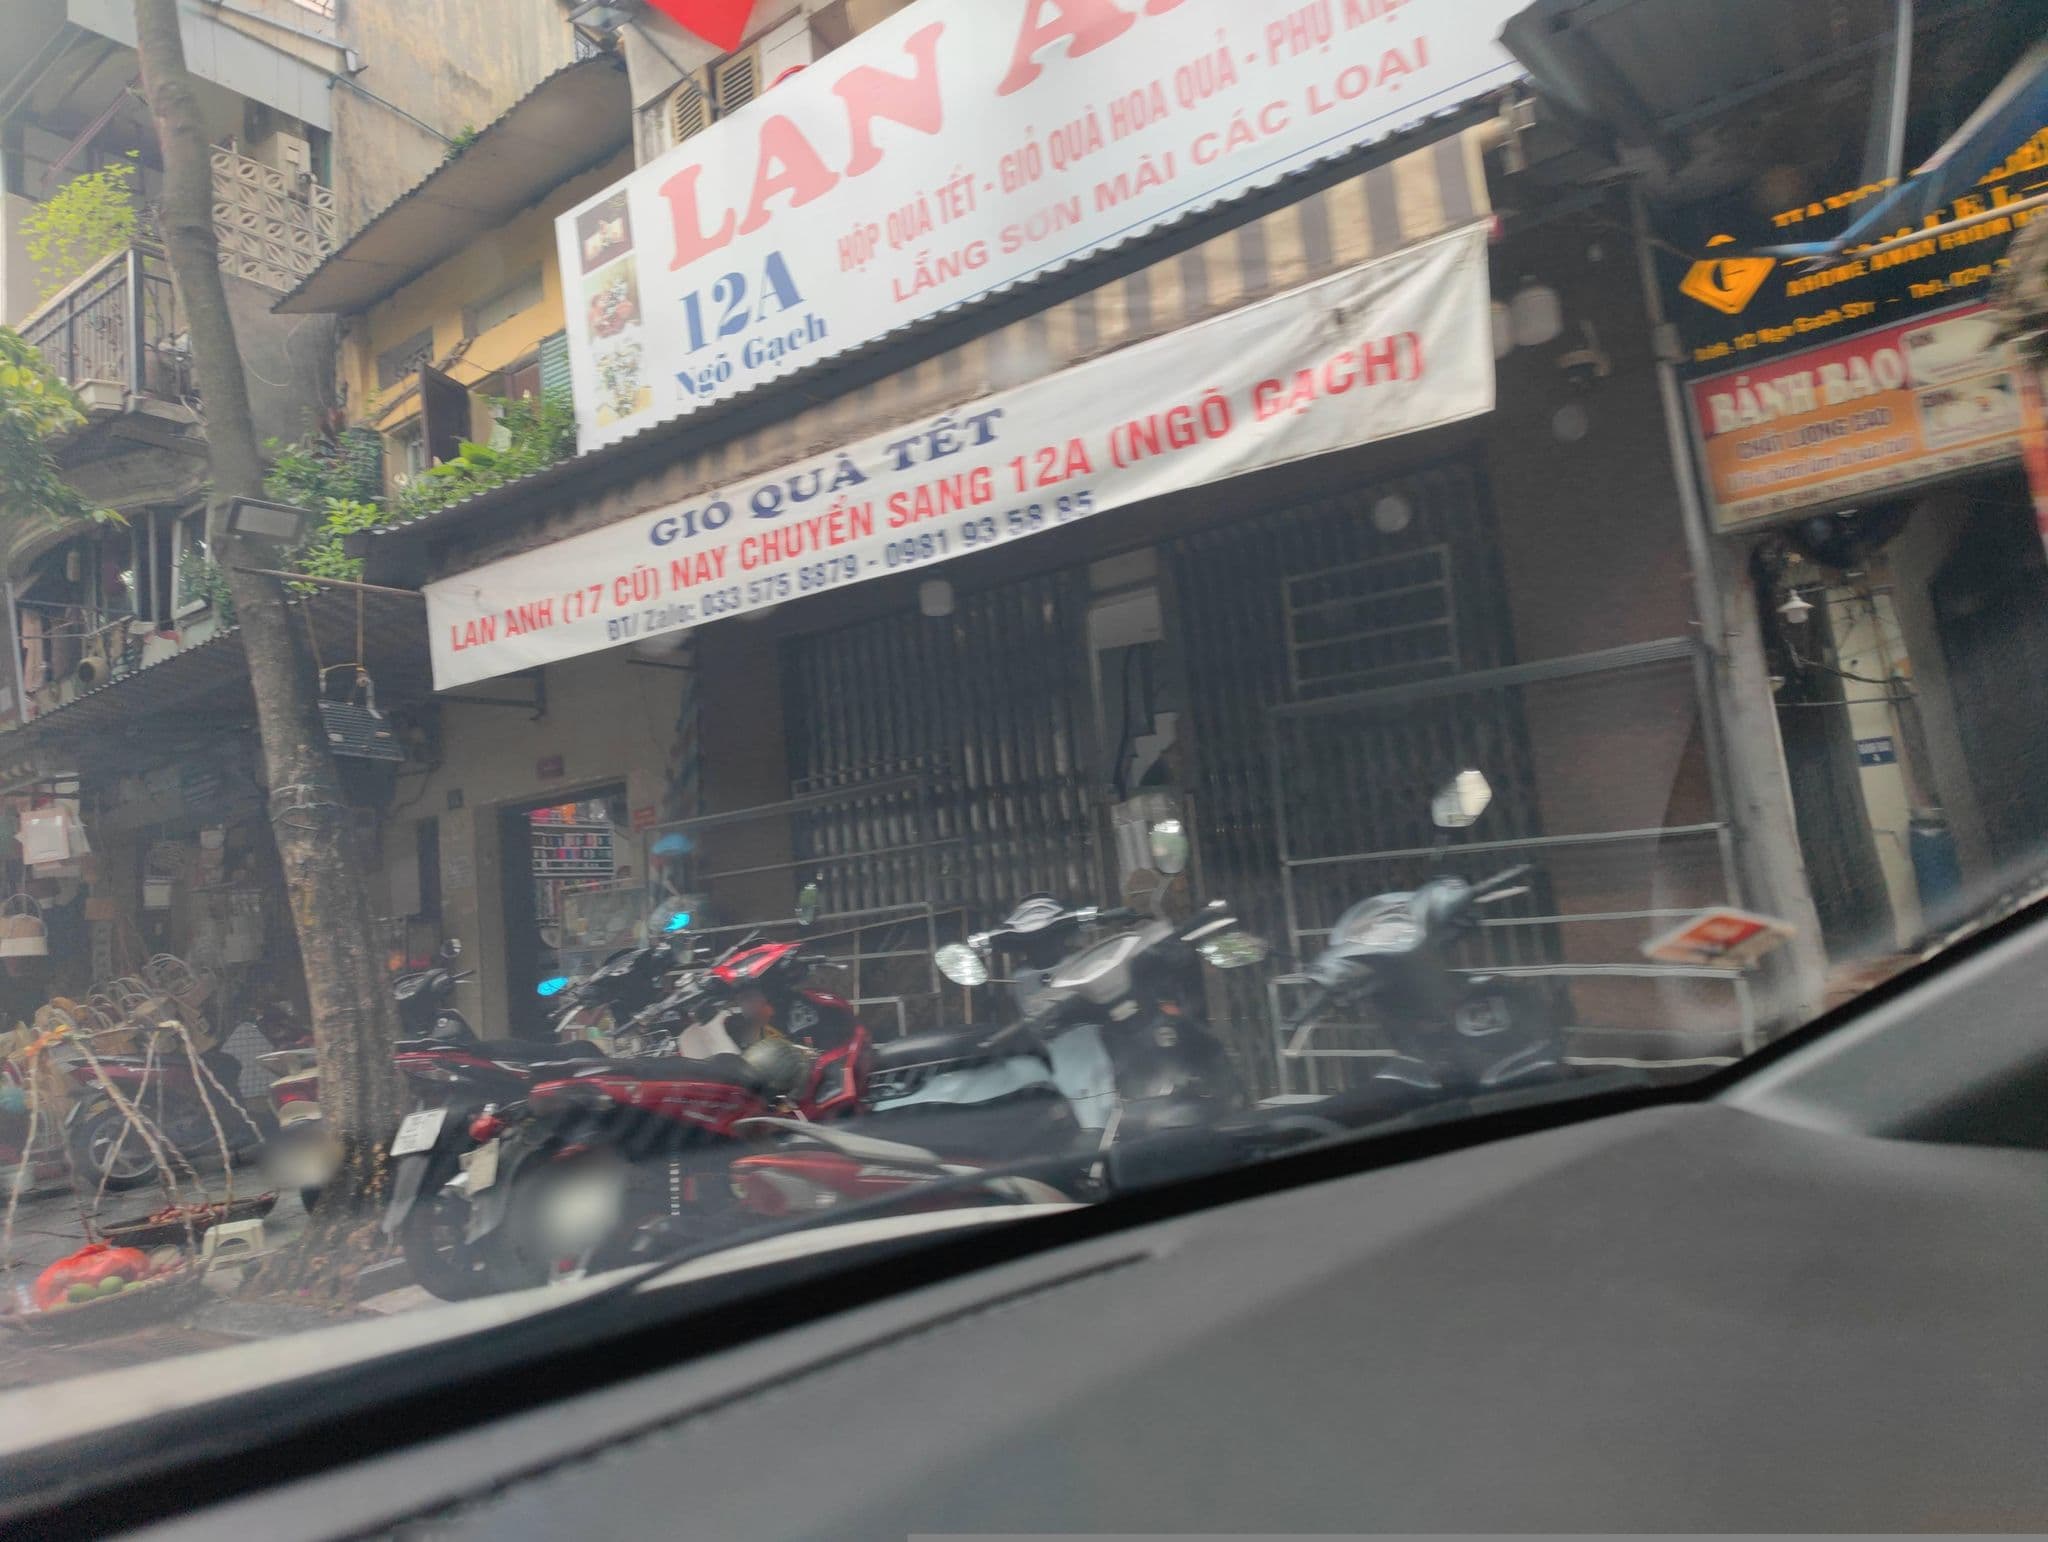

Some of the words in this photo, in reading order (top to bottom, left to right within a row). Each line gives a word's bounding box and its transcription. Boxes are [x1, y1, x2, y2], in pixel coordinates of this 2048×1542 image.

[659, 22, 945, 272] LAN
[935, 163, 977, 225] TẾT
[1108, 79, 1169, 142] HOA
[1092, 153, 1176, 214] MÀI
[1190, 106, 1293, 167] CÁC
[1305, 35, 1430, 116] LOẠI
[675, 352, 734, 400] Ngõ
[742, 312, 829, 370] Gạch
[680, 250, 806, 355] 12A
[451, 614, 497, 653] LAN
[504, 597, 554, 638] ANH
[562, 583, 605, 625] (17
[670, 544, 729, 592] NAY
[739, 495, 874, 571] CHUYỂN
[886, 465, 994, 529] SANG
[1008, 437, 1094, 493] 12A
[1251, 330, 1426, 423] GẠCH)
[883, 407, 1005, 472] TẾT
